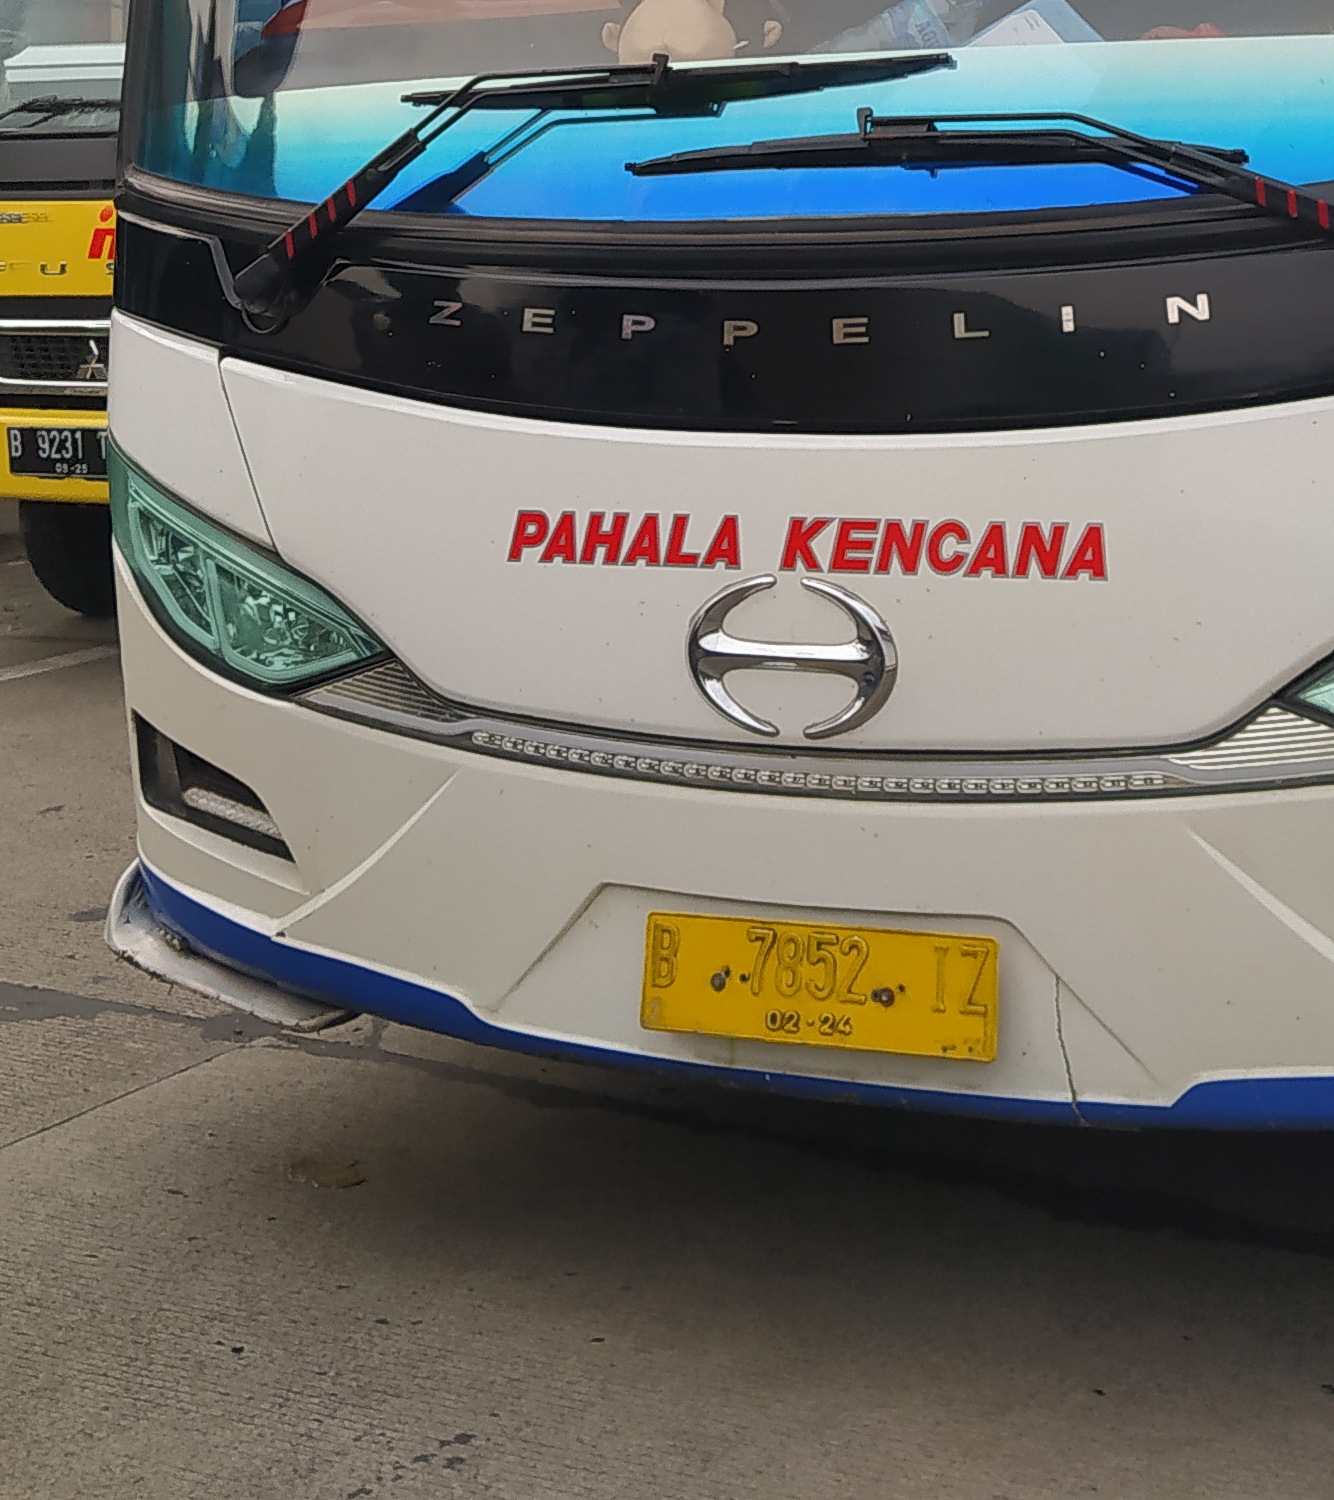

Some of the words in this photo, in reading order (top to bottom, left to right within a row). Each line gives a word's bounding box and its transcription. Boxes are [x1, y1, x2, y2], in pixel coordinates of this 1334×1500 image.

[428, 292, 1212, 347] ZEPPELIN
[10, 429, 22, 457] B
[37, 430, 83, 459] 9231
[508, 510, 743, 571] PAHALA
[779, 516, 1110, 583] KENCANA
[651, 921, 681, 989] B
[746, 927, 871, 1004] 7852
